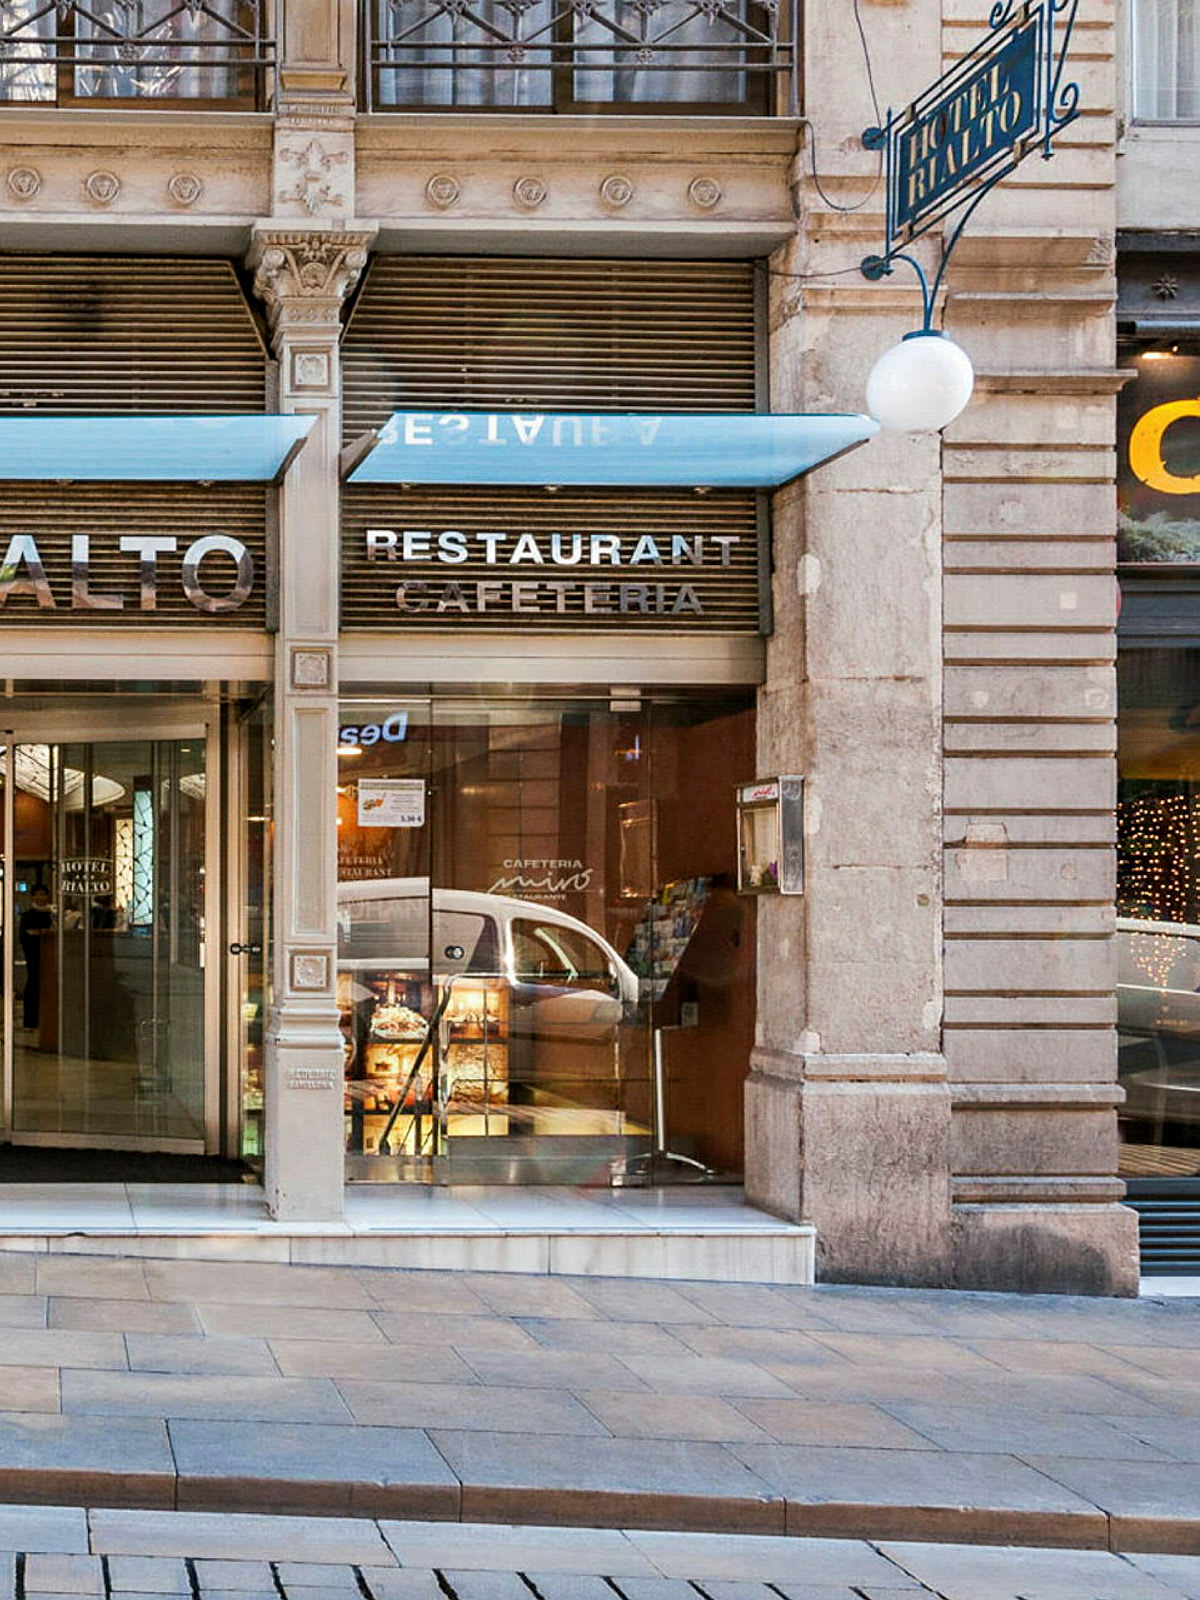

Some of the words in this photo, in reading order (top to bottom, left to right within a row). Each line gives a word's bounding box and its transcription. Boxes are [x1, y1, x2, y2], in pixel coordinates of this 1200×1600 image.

[910, 63, 1010, 170] HOTEL
[908, 90, 1022, 207] RIALTO
[365, 529, 741, 567] RESTAURANT
[395, 579, 705, 615] CAFETERIA
[61, 861, 110, 874] HOTEL
[503, 859, 583, 869] CAFETERIA
[61, 880, 111, 893] RIALTO
